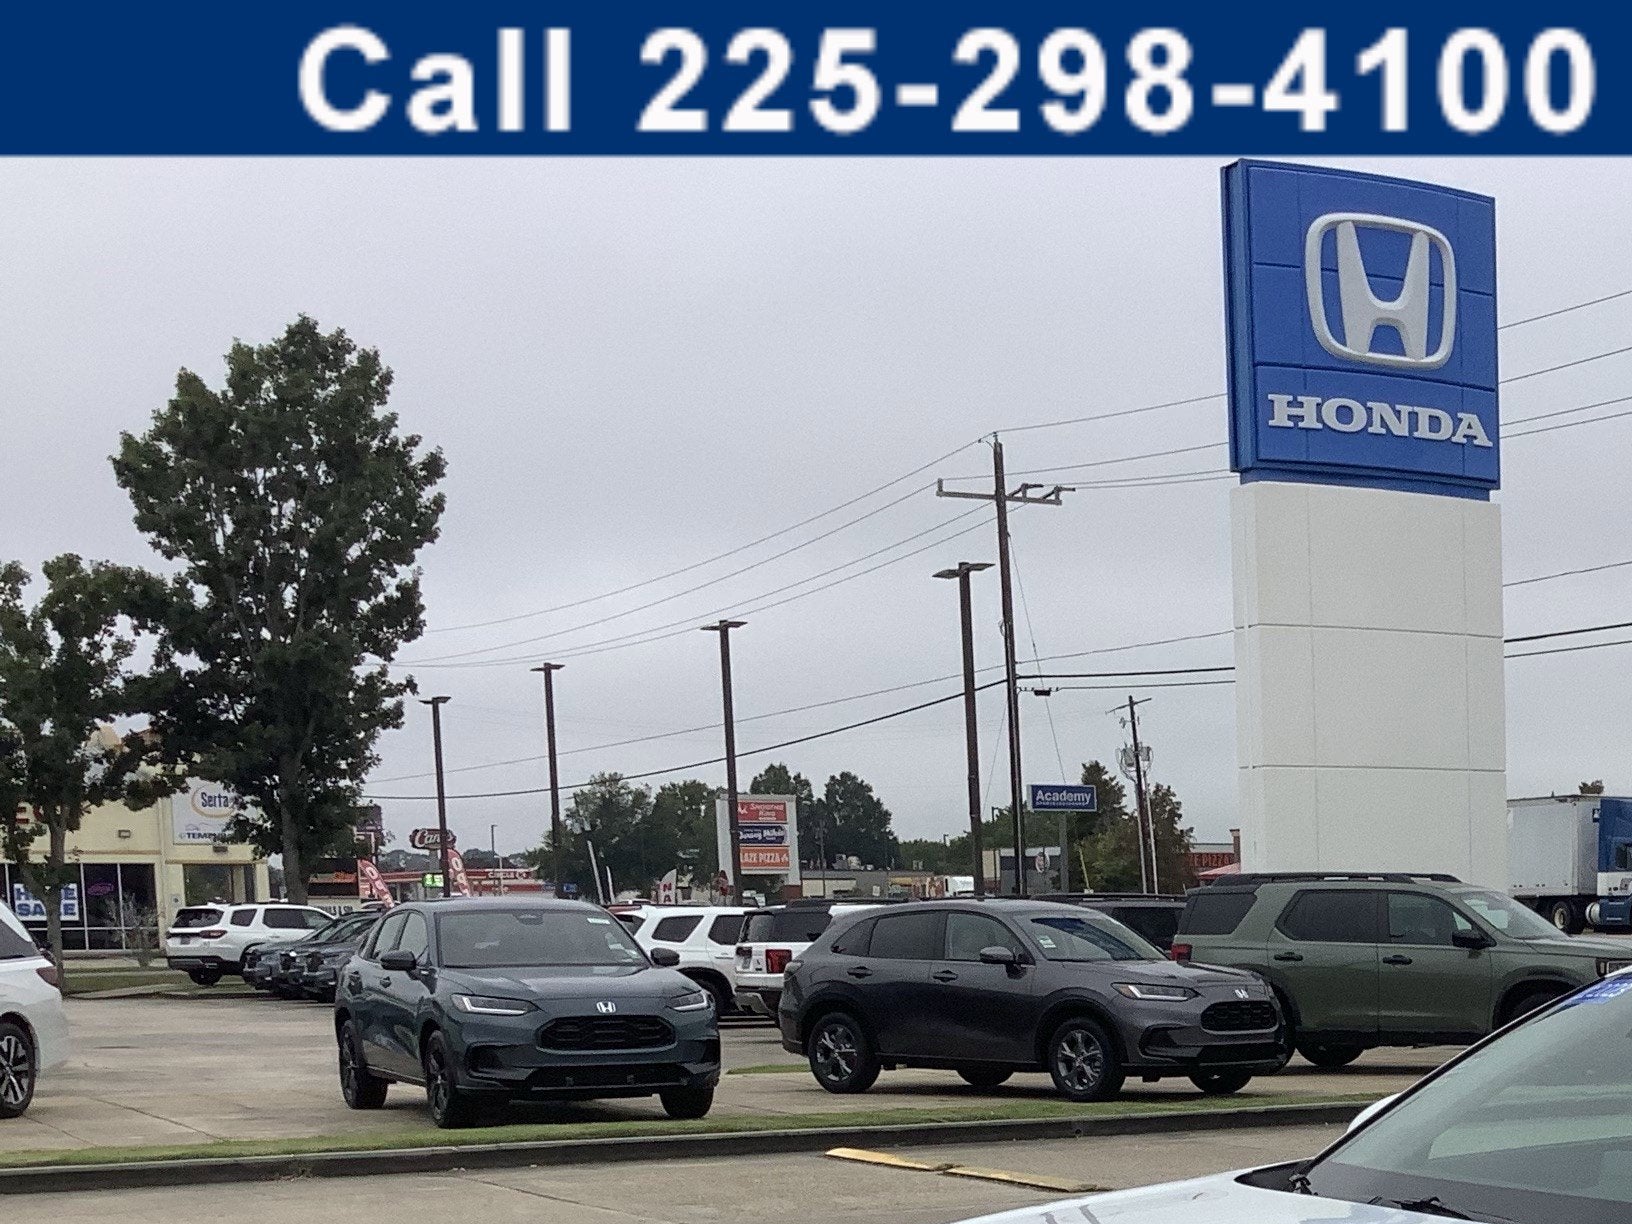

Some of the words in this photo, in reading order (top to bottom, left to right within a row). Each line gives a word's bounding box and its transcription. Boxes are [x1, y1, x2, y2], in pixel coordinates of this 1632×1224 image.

[1268, 393, 1493, 448] HONDA
[201, 791, 230, 808] Serta
[1035, 789, 1091, 806] Academy
[758, 852, 781, 864] PIZZA
